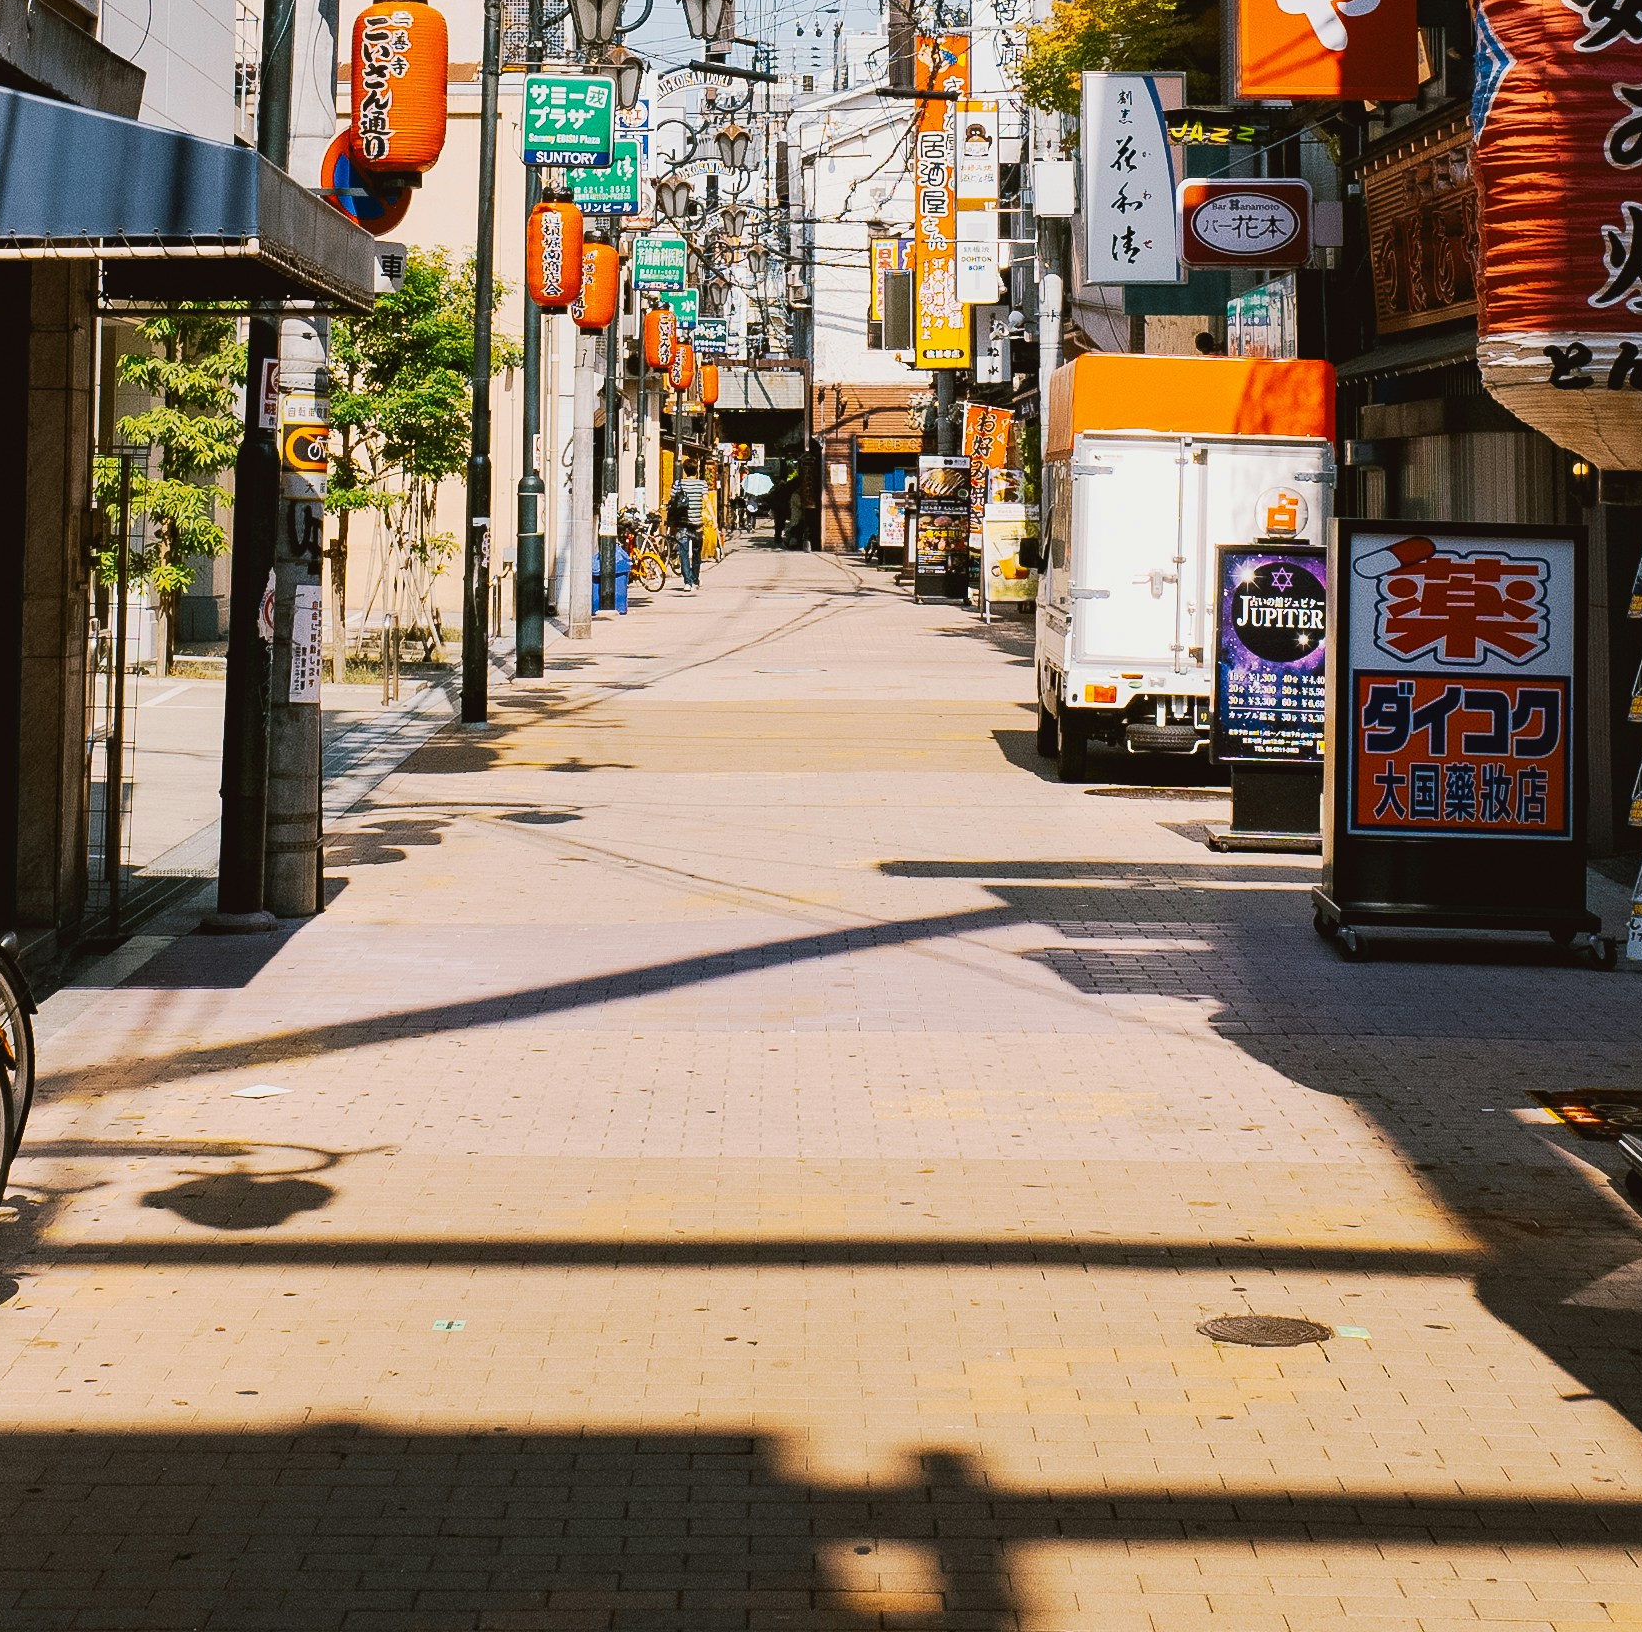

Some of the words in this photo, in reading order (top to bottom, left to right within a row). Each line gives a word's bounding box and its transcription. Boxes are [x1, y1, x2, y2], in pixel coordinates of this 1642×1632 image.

[359, 14, 394, 161] こいさん通り
[529, 84, 585, 105] サミー
[529, 106, 596, 130] プラザ
[982, 102, 996, 111] 2F
[1170, 120, 1256, 143] JAZZ
[535, 151, 598, 165] SUNTORY
[1203, 214, 1288, 240] バー花本
[380, 253, 404, 281] 車
[1236, 595, 1325, 629] JUPITER
[1383, 557, 1541, 660] 薬
[1361, 679, 1562, 759] ダイコク
